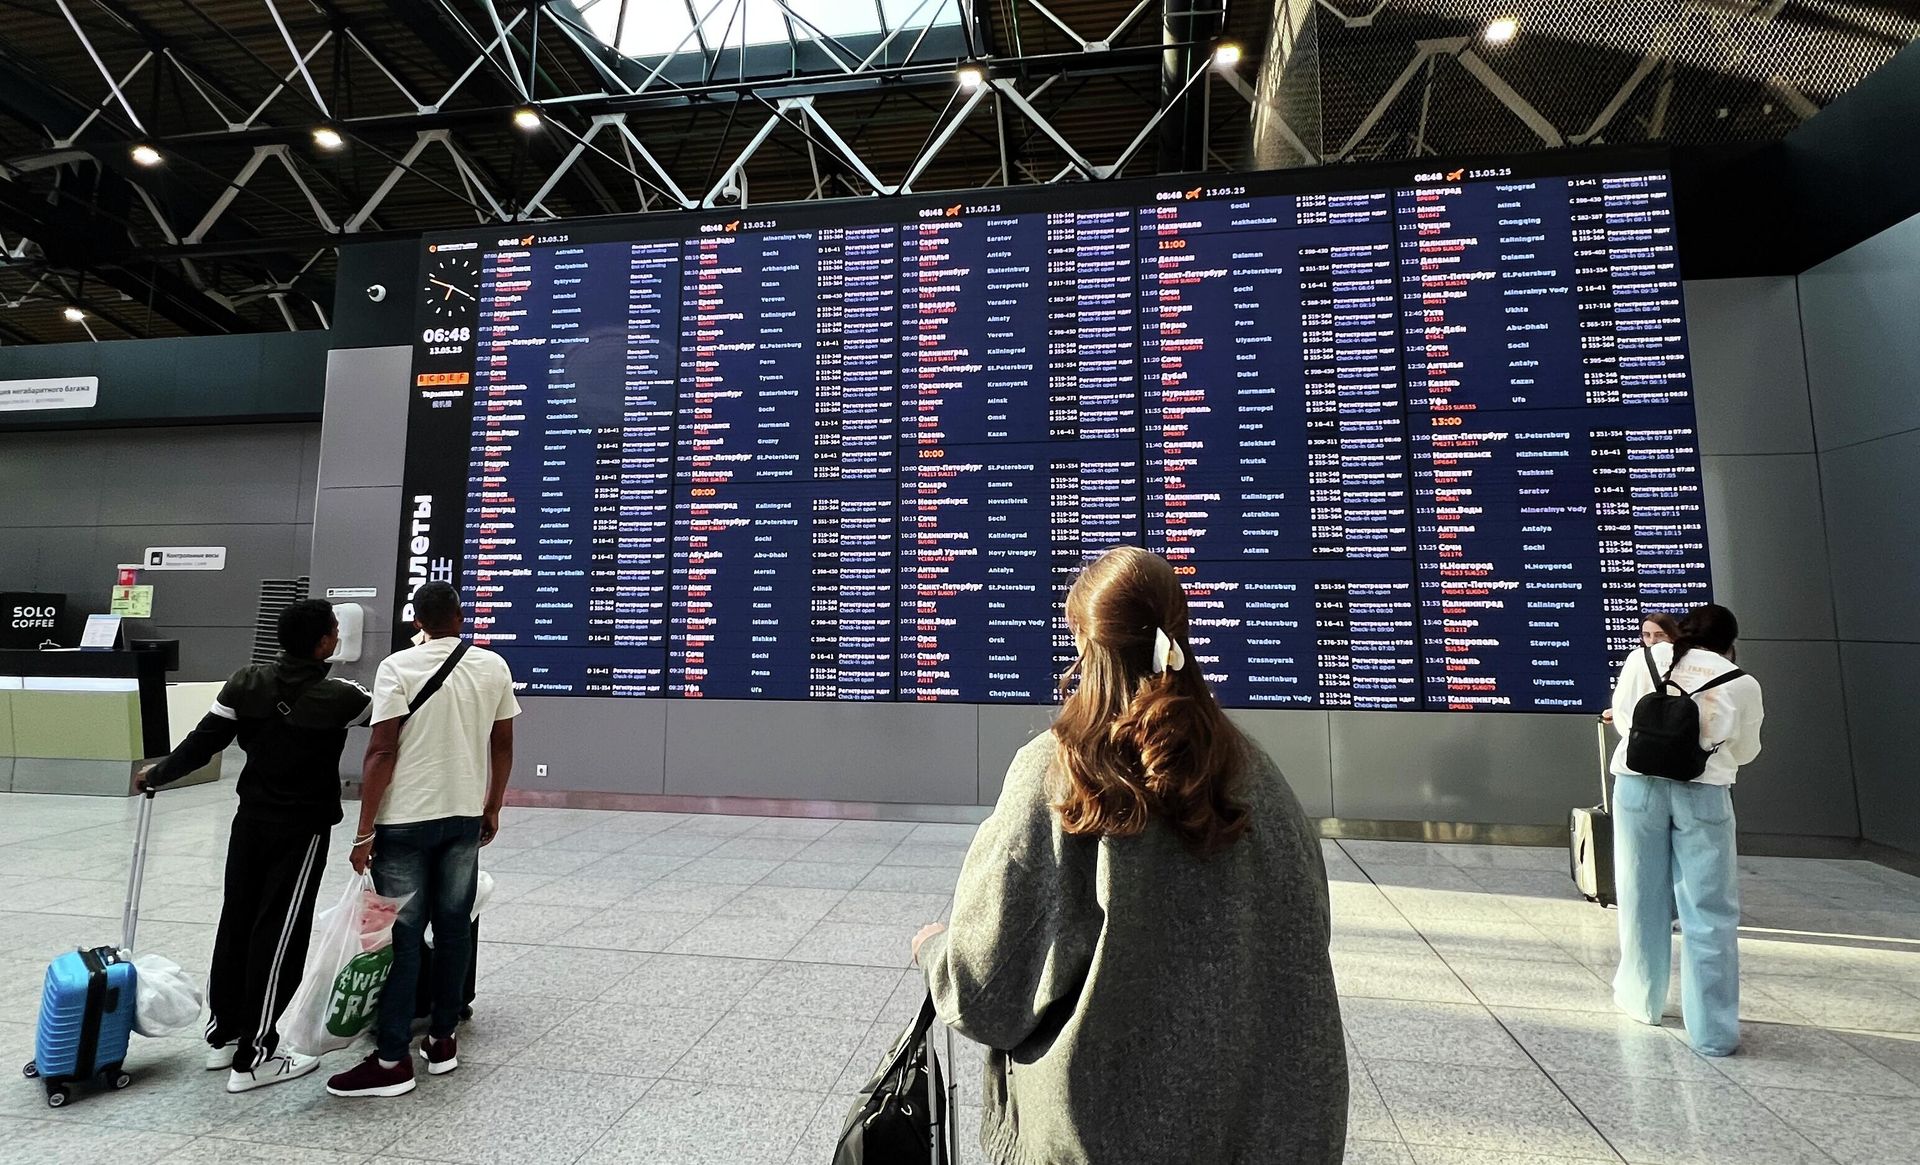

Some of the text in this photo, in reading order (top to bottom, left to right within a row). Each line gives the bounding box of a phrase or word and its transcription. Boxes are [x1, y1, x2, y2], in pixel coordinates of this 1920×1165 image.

[1470, 168, 1511, 178] 13.05.25
[1207, 187, 1245, 196] 13.05.25
[1159, 240, 1185, 249] 11:00
[423, 327, 470, 343] 06:48
[429, 346, 462, 355] 13.05.25
[1432, 417, 1462, 426] 13:00
[1515, 432, 1570, 440] St.Petersburg
[1438, 544, 1461, 552] Сочи
[1007, 549, 1036, 557] Urengoy
[1440, 562, 1493, 572] Н.Новгород
[917, 583, 983, 591] Санкт-Петербург
[1442, 600, 1503, 610] Калининград
[13, 606, 56, 618] SOLO
[12, 619, 55, 628] COFFEE
[1443, 619, 1478, 629] Самара
[1448, 695, 1510, 706] Калининград
